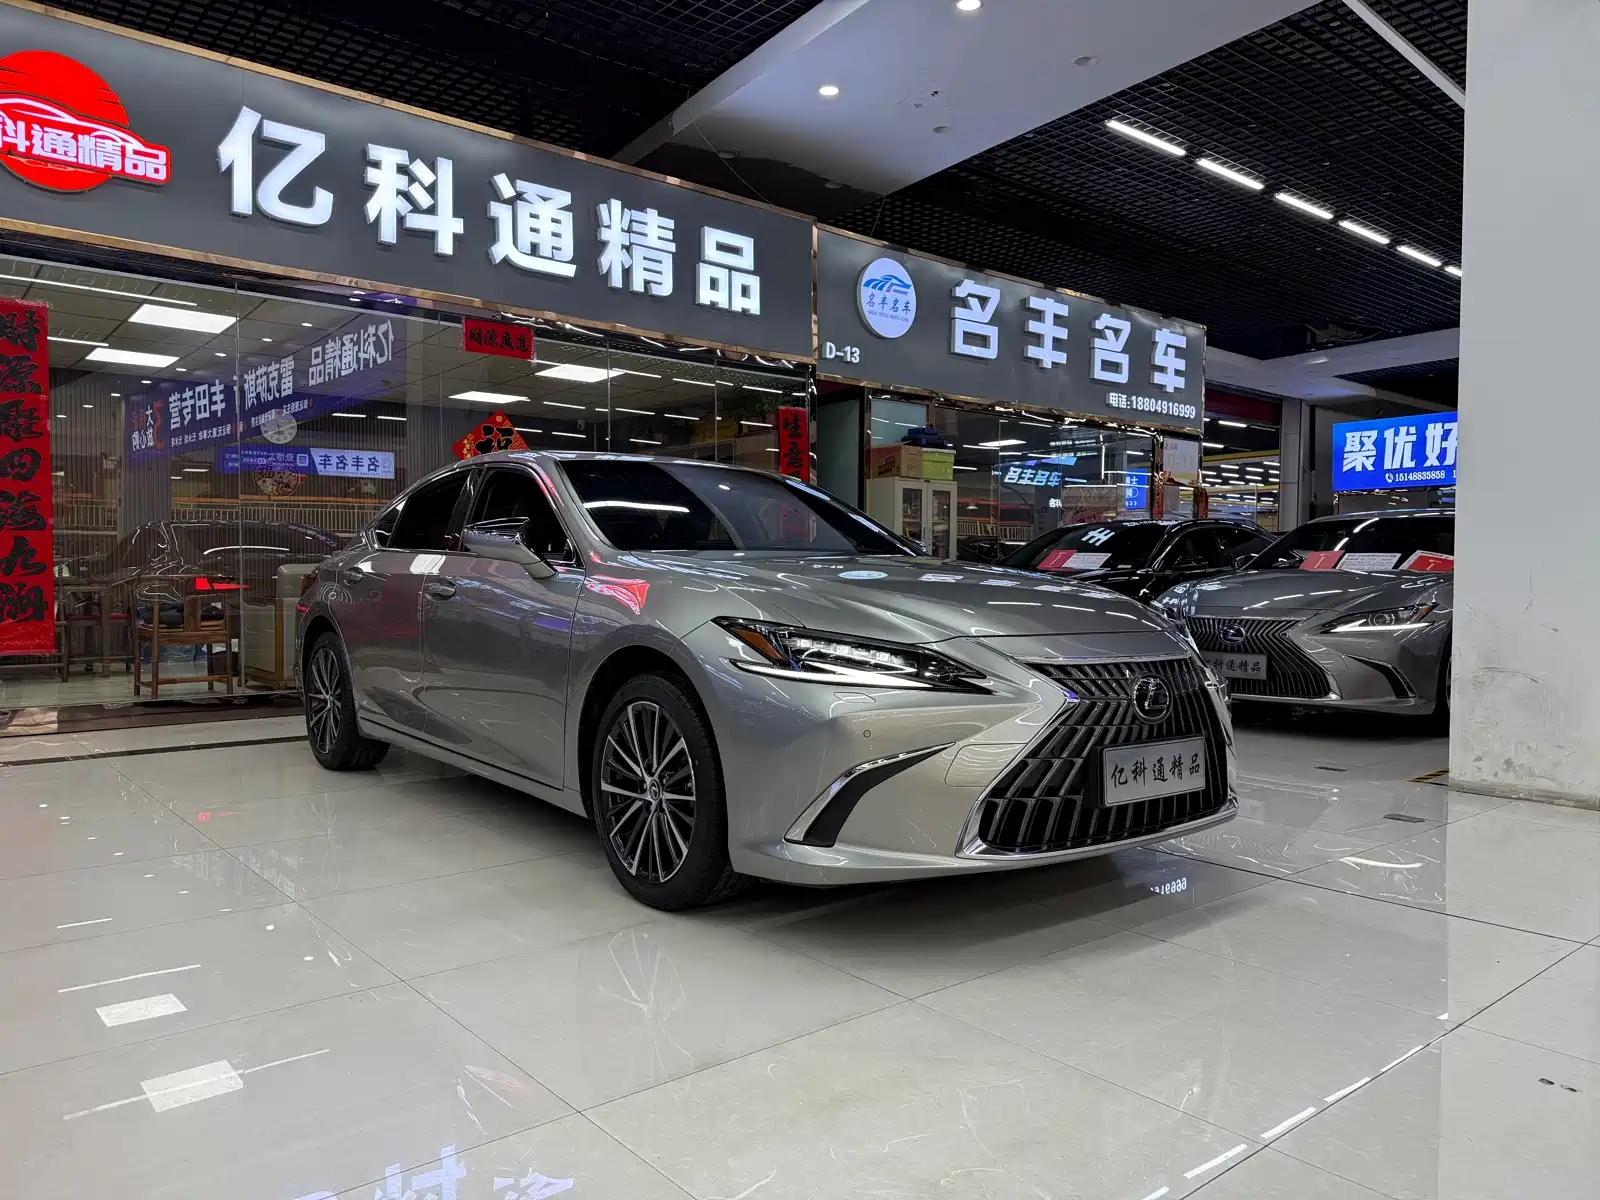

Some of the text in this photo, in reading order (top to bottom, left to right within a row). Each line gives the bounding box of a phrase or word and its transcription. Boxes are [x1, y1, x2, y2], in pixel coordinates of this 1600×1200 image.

[216, 106, 762, 316] 亿科通精品
[866, 292, 912, 316] 名丰名车
[824, 340, 860, 364] D-13
[950, 279, 1188, 393] 名丰名车
[1342, 421, 1458, 473] 聚优好
[1395, 470, 1446, 482] 15148835858
[1110, 752, 1201, 788] 亿科通精品
